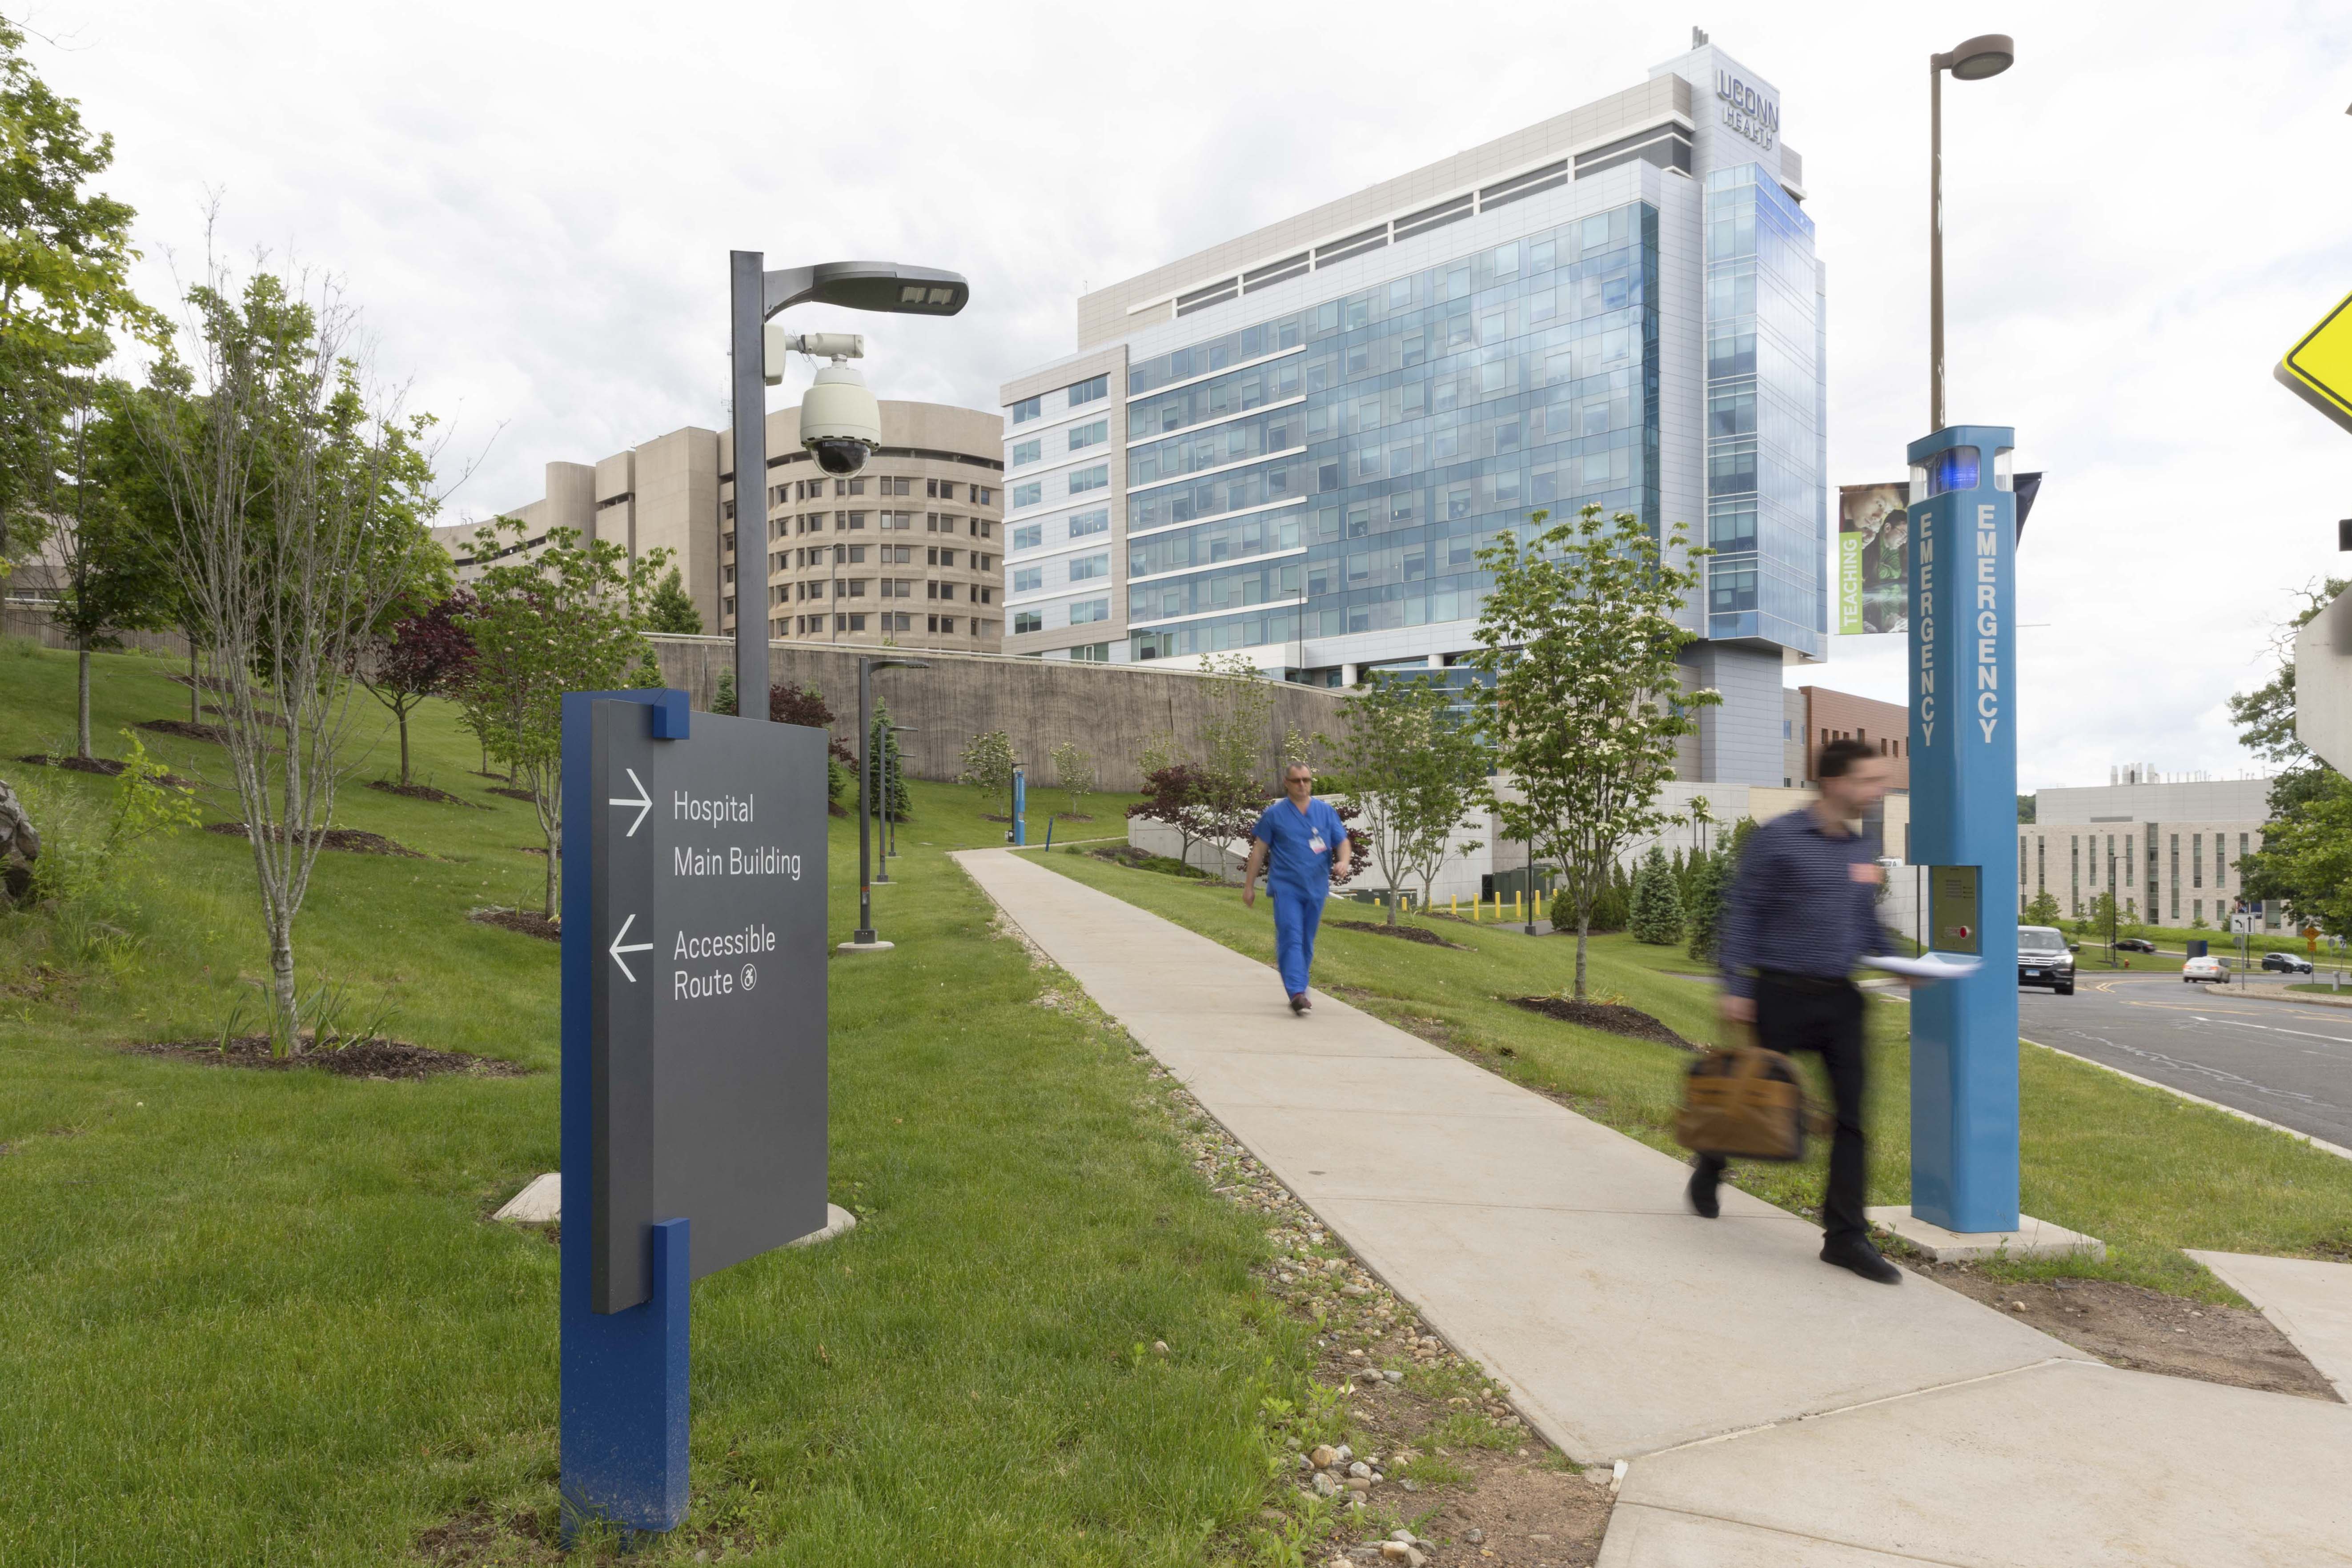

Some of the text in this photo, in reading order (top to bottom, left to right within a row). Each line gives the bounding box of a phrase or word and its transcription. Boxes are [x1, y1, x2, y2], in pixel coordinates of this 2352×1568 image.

[1718, 69, 1778, 132] UCONN
[1725, 106, 1773, 150] HEALTH
[1843, 539, 1858, 627] TEACHING
[1920, 512, 1935, 746] EMERGENCY
[1977, 504, 1998, 744] EMERGENCY
[674, 790, 754, 829] Hospital
[674, 846, 801, 881] Main Building
[674, 923, 775, 960] Accessible
[675, 969, 733, 1000] Route
